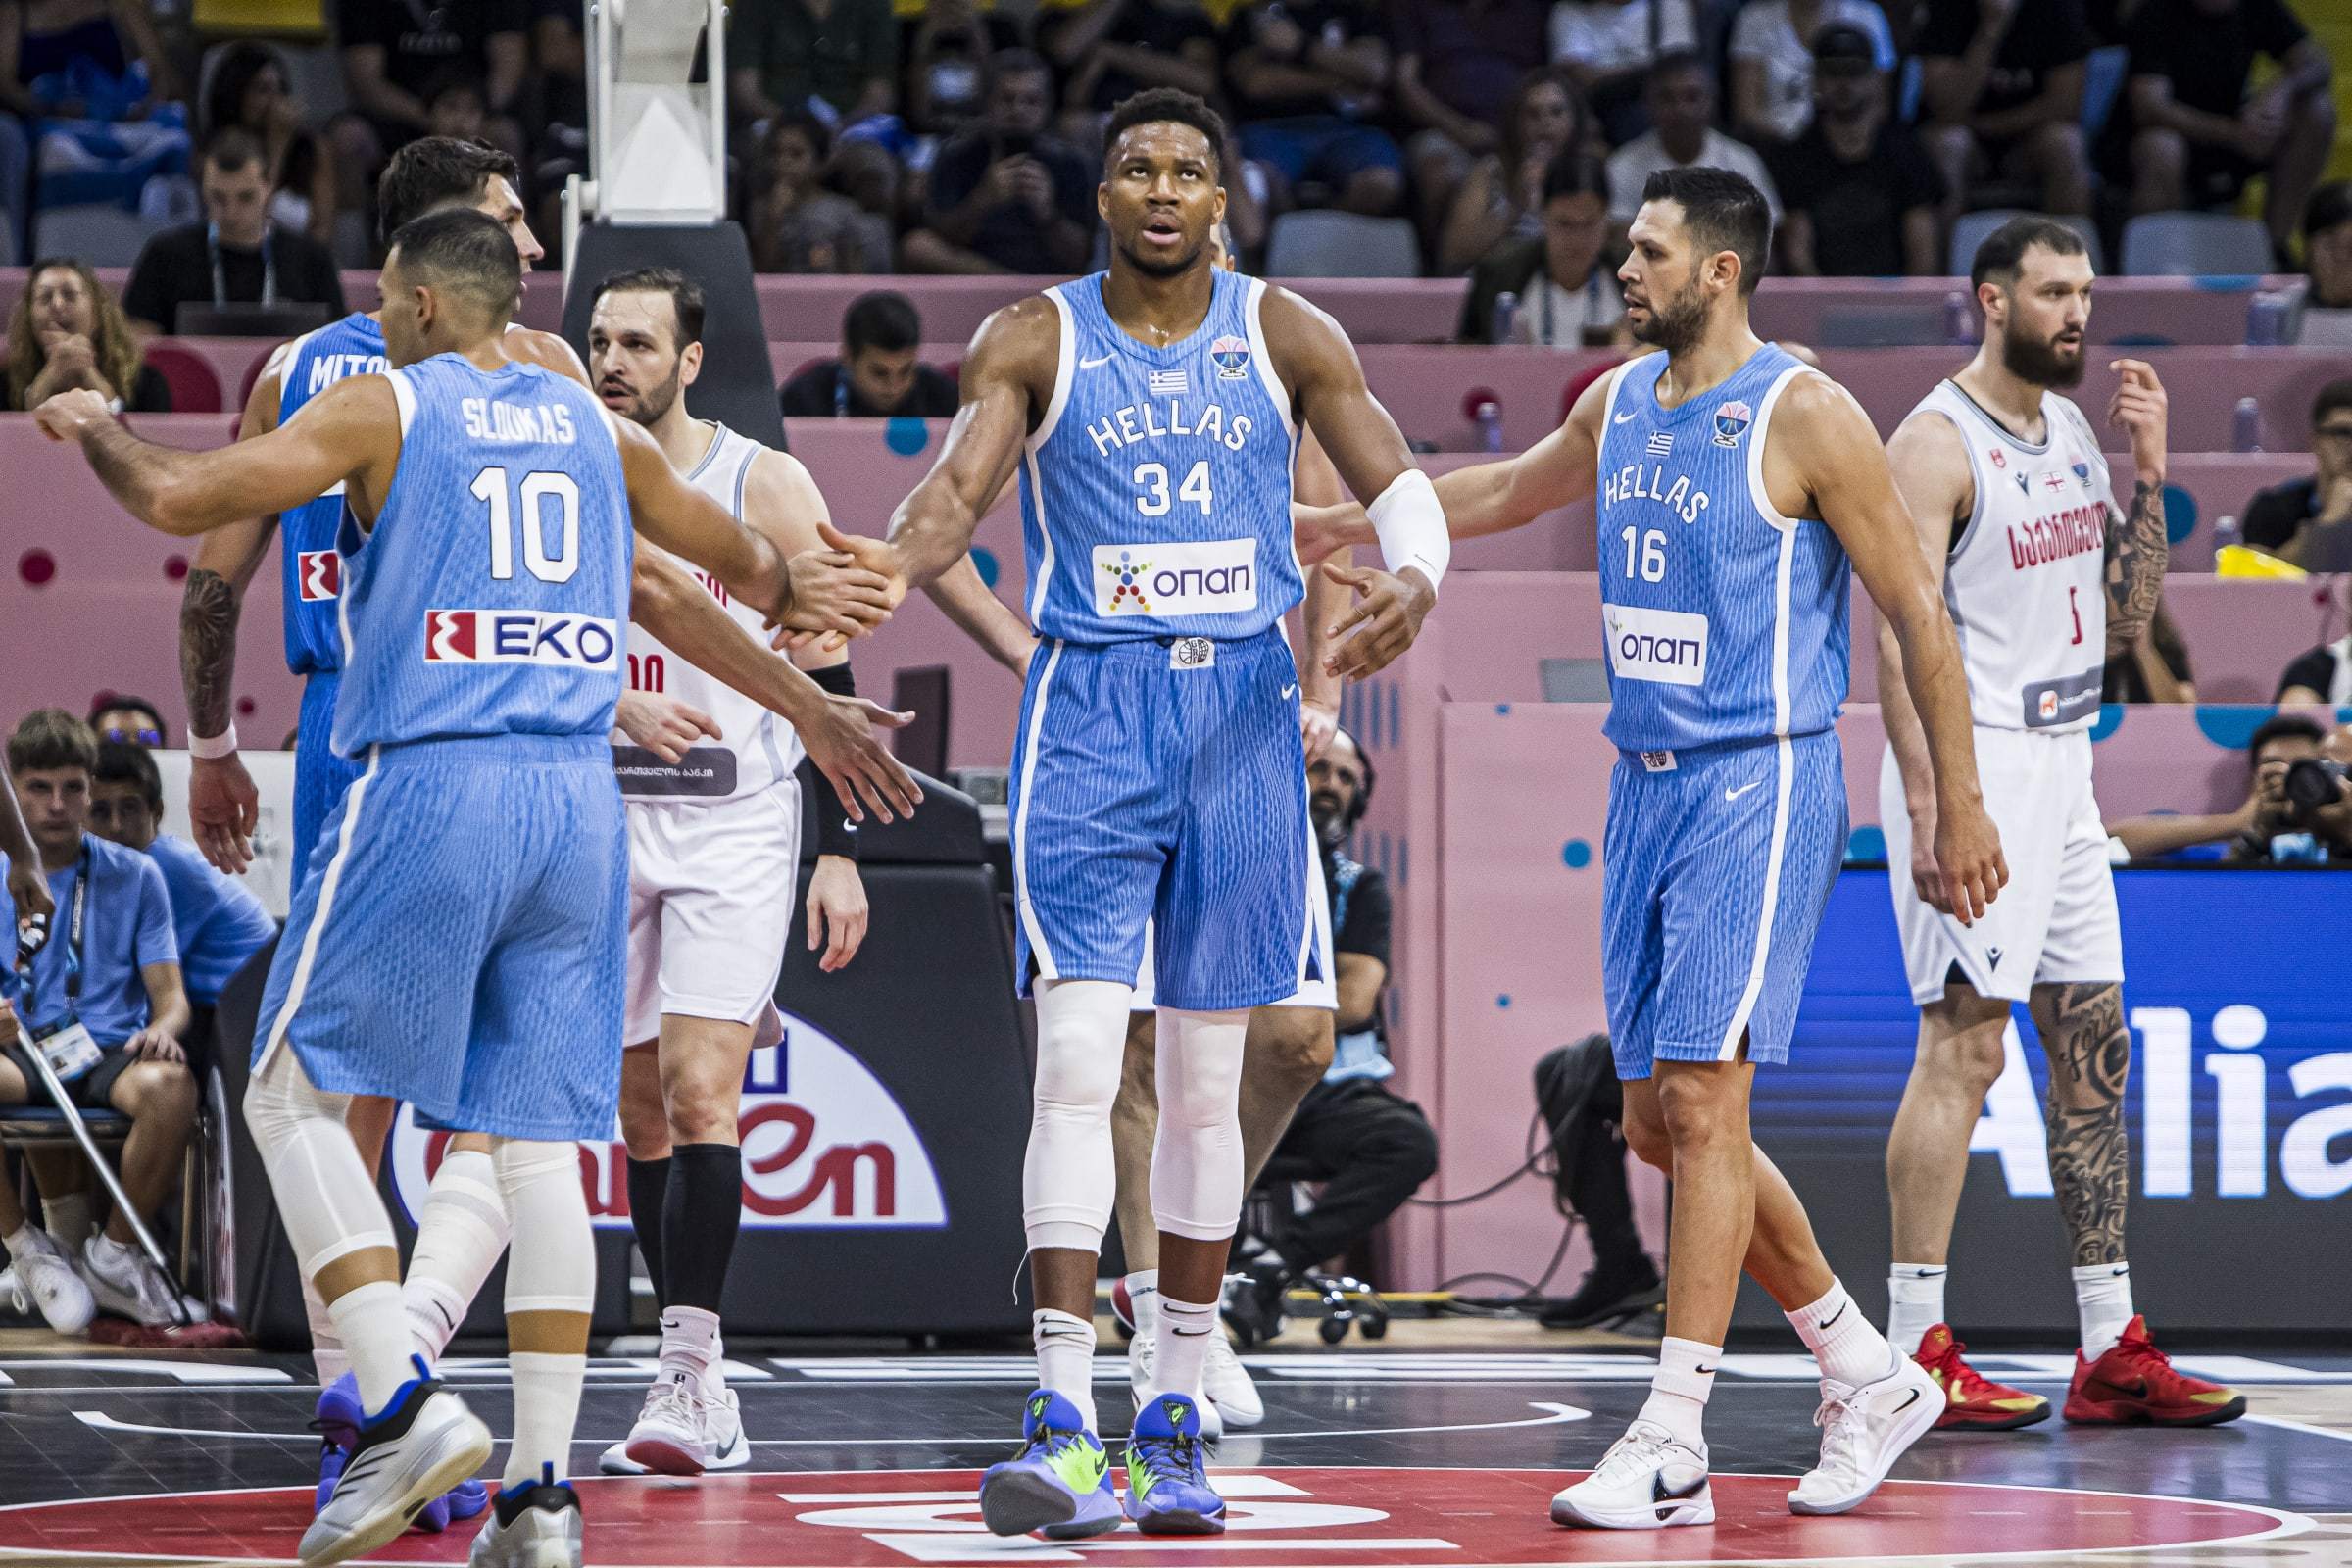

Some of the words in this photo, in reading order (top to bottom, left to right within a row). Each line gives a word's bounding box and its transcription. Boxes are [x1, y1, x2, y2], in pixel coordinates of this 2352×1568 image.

[308, 354, 393, 395] MITO
[461, 397, 577, 444] SLOUKAS
[1086, 399, 1253, 458] HELLAS
[1132, 461, 1213, 517] 34
[1603, 463, 1710, 525] HELLAS
[469, 466, 580, 584] 10
[1621, 524, 1667, 583] 16
[493, 615, 614, 664] EKO
